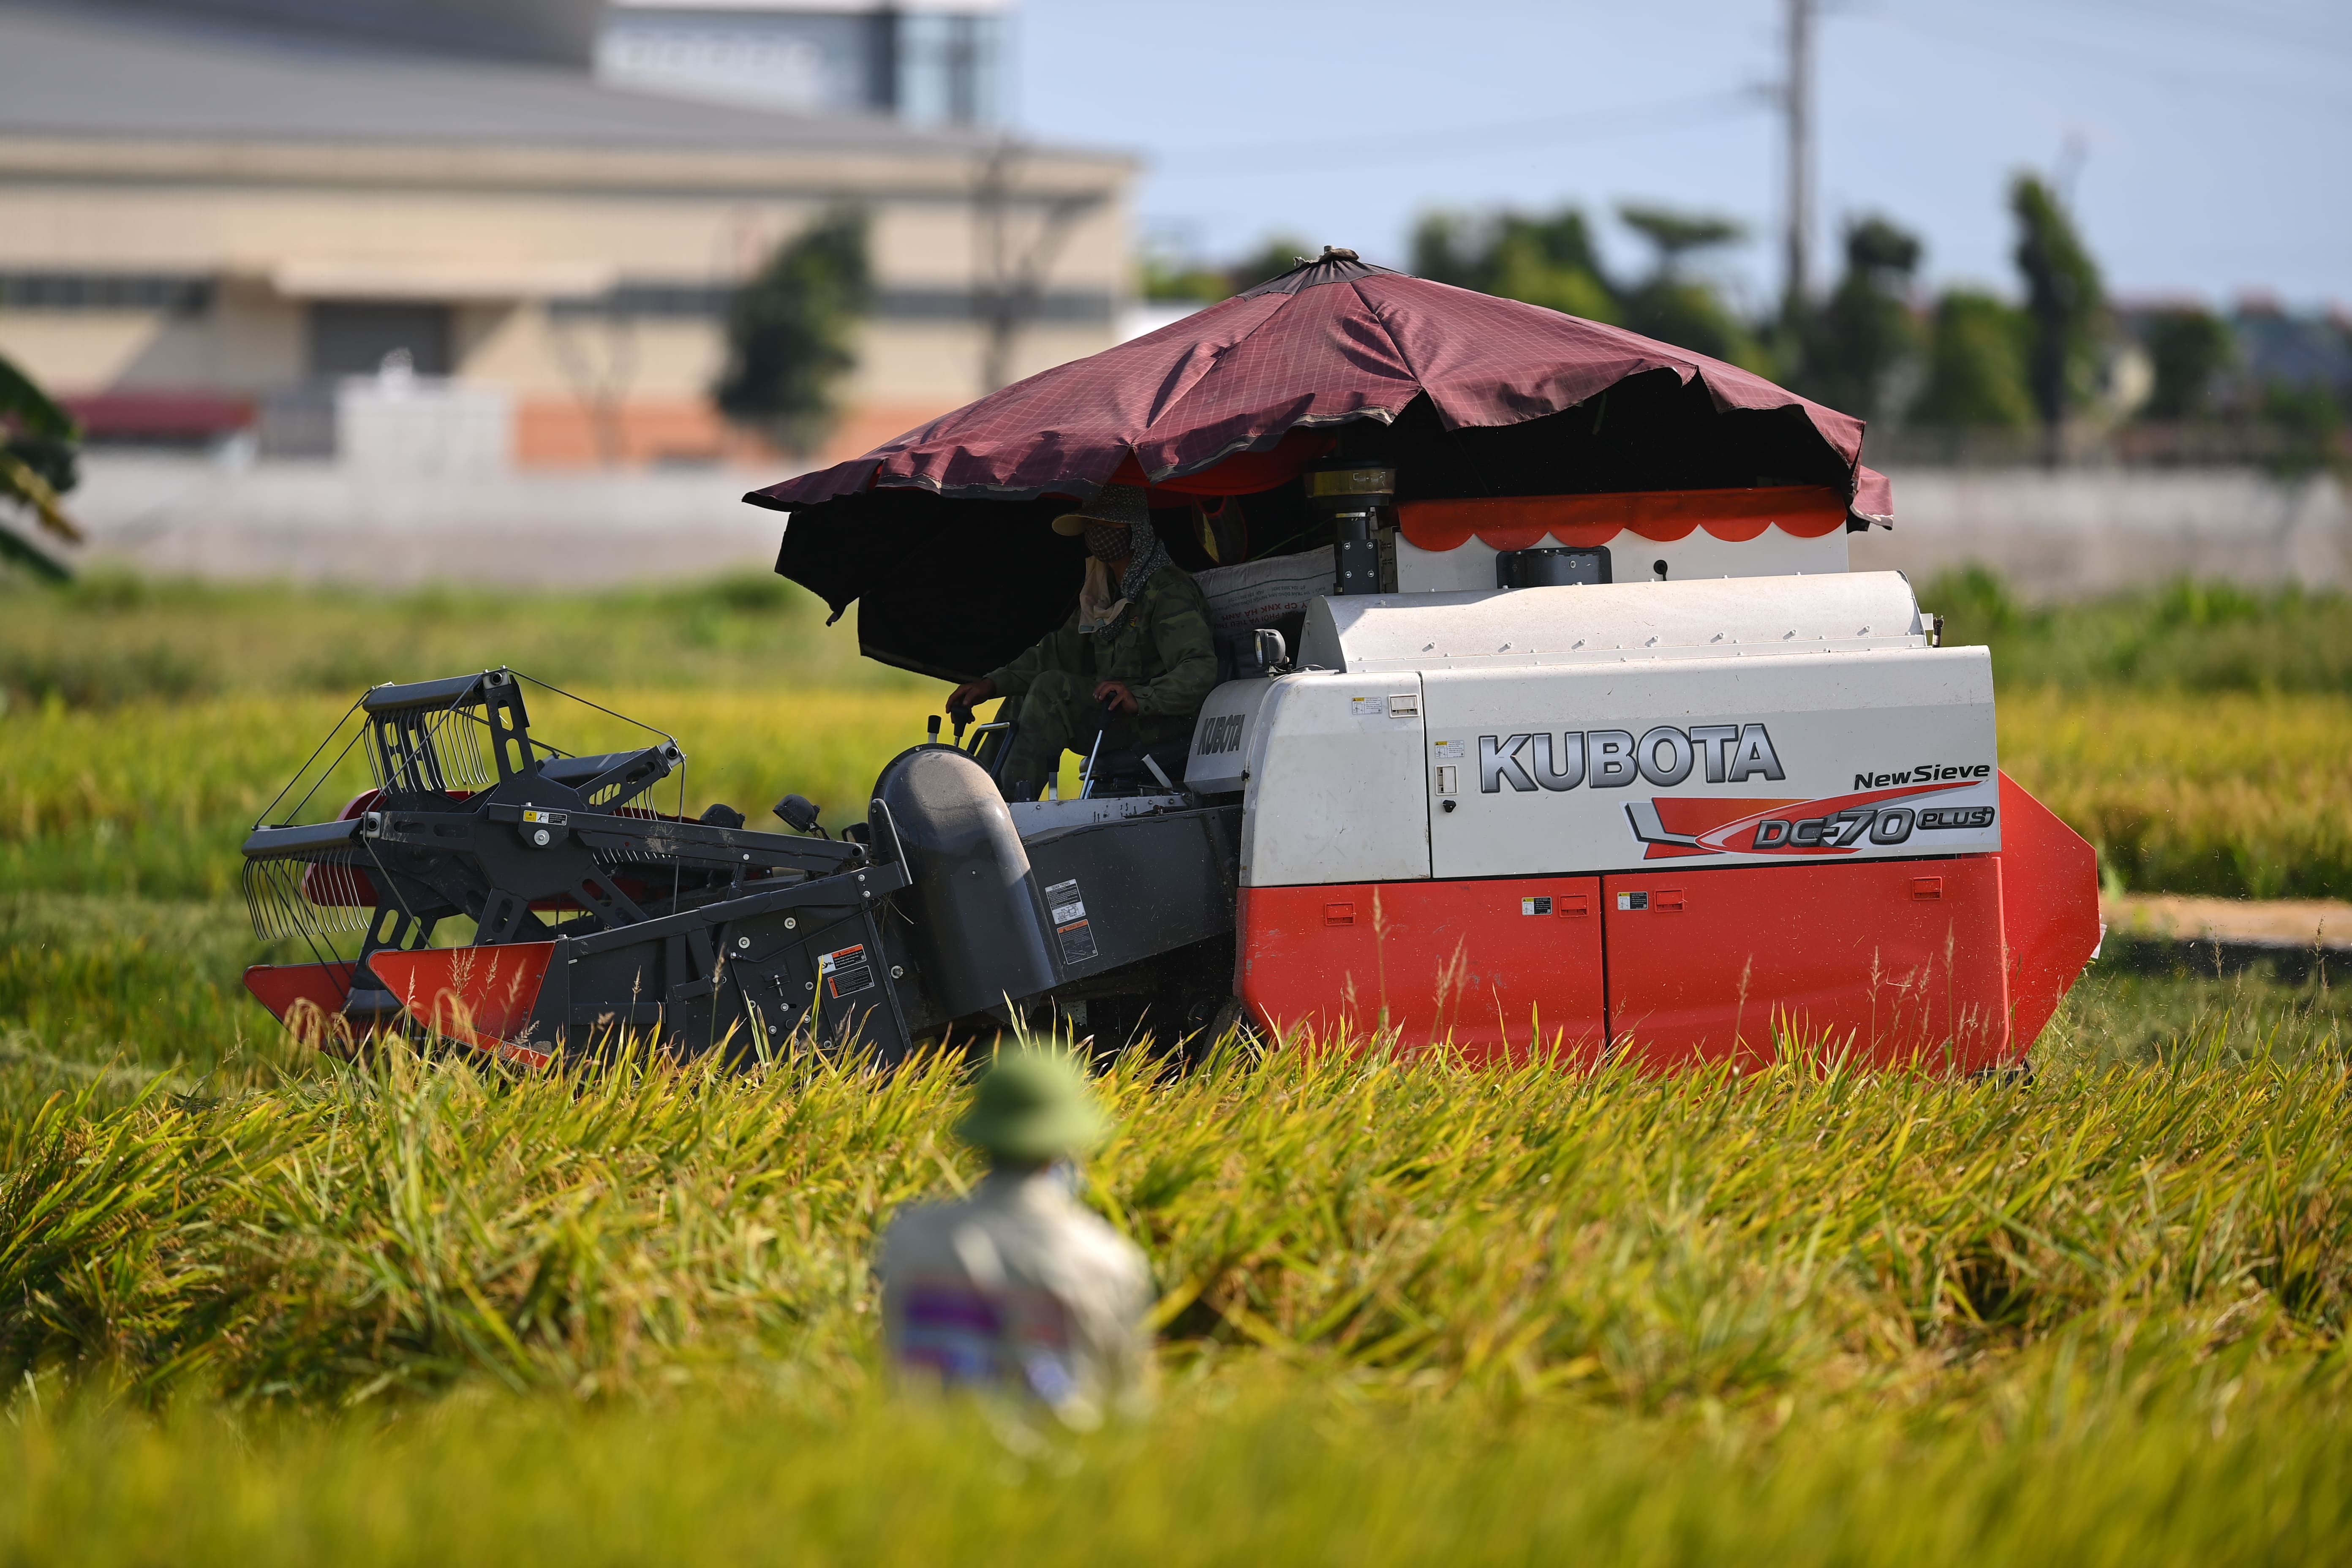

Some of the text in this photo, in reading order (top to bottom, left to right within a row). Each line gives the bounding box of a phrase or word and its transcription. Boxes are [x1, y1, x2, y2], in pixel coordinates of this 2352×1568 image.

[1222, 612, 1241, 621] ANH
[1244, 609, 1258, 618] HÀ
[1261, 603, 1281, 613] XNK
[1197, 714, 1245, 755] KUBOTA
[1479, 723, 1786, 793] KUBOTA
[1752, 808, 1916, 849] DC-70
